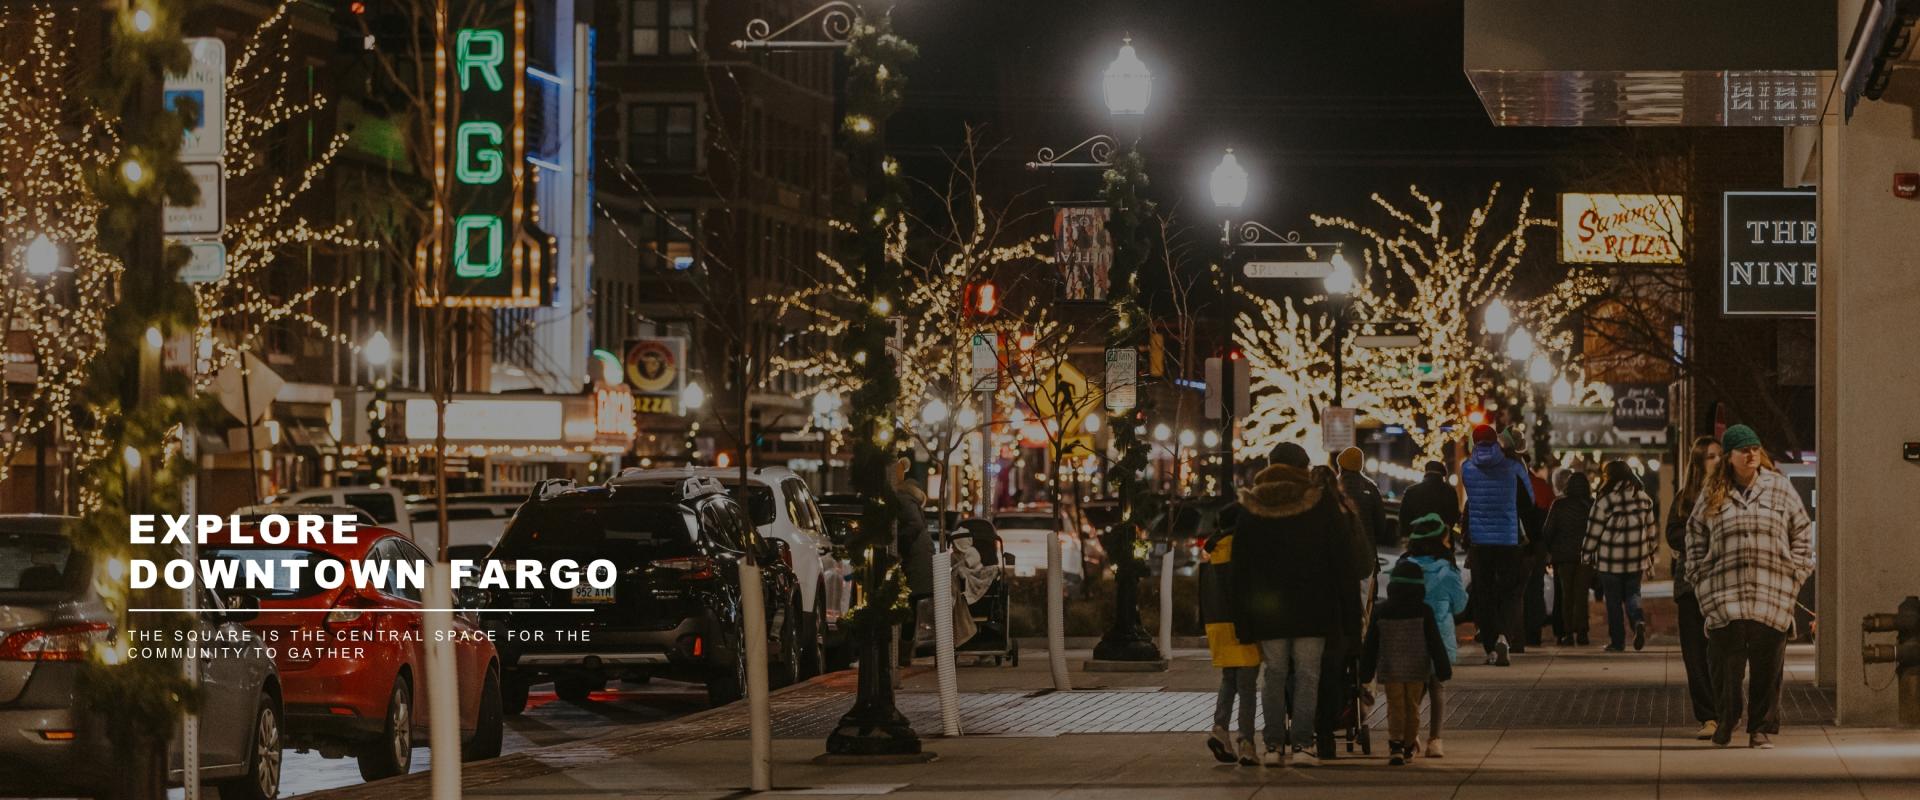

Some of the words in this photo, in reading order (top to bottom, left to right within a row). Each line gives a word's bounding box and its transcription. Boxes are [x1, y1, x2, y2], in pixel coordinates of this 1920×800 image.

[1746, 220, 1816, 244] THE
[1729, 261, 1816, 286] NINE
[635, 398, 672, 413] IZZA
[576, 587, 593, 598] 952
